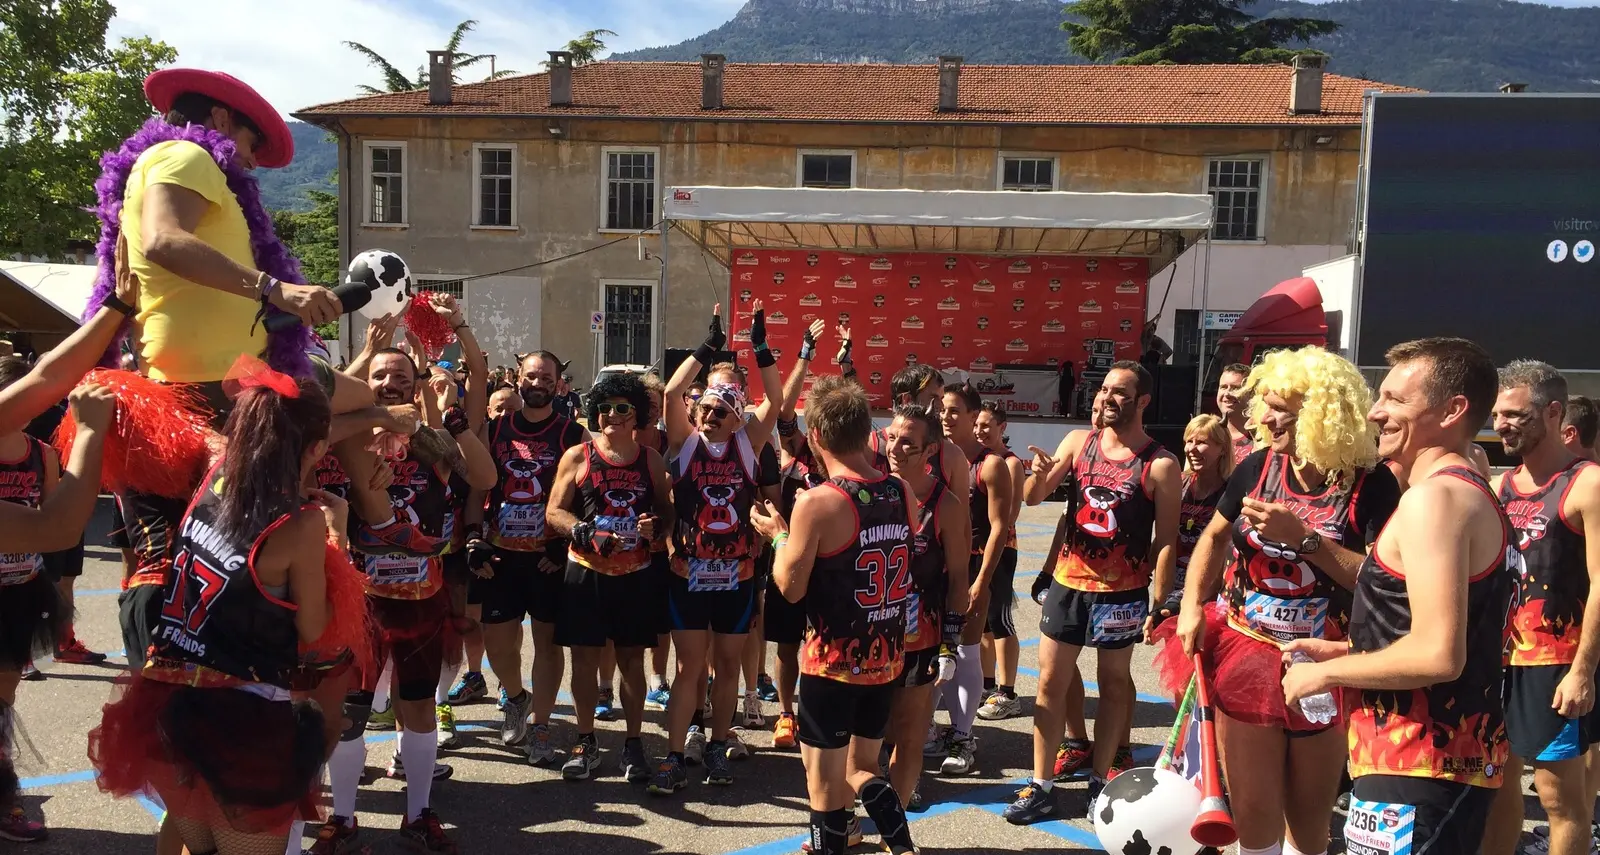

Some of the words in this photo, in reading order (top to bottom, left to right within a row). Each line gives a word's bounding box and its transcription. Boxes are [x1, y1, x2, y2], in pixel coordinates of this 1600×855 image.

[1006, 400, 1039, 412] FRIEND
[514, 510, 527, 519] 768
[614, 522, 628, 531] 514
[859, 524, 910, 548] RUNNING
[706, 563, 721, 572] 958
[854, 543, 909, 609] 32
[161, 545, 230, 636] 17
[867, 605, 900, 623] FRIENDS
[1112, 610, 1131, 621] 1610
[1274, 608, 1299, 622] 427
[162, 626, 206, 657] FRIENDS
[1443, 756, 1484, 769] HOME
[1350, 808, 1377, 833] 3236
[1366, 835, 1391, 849] FRIEND
